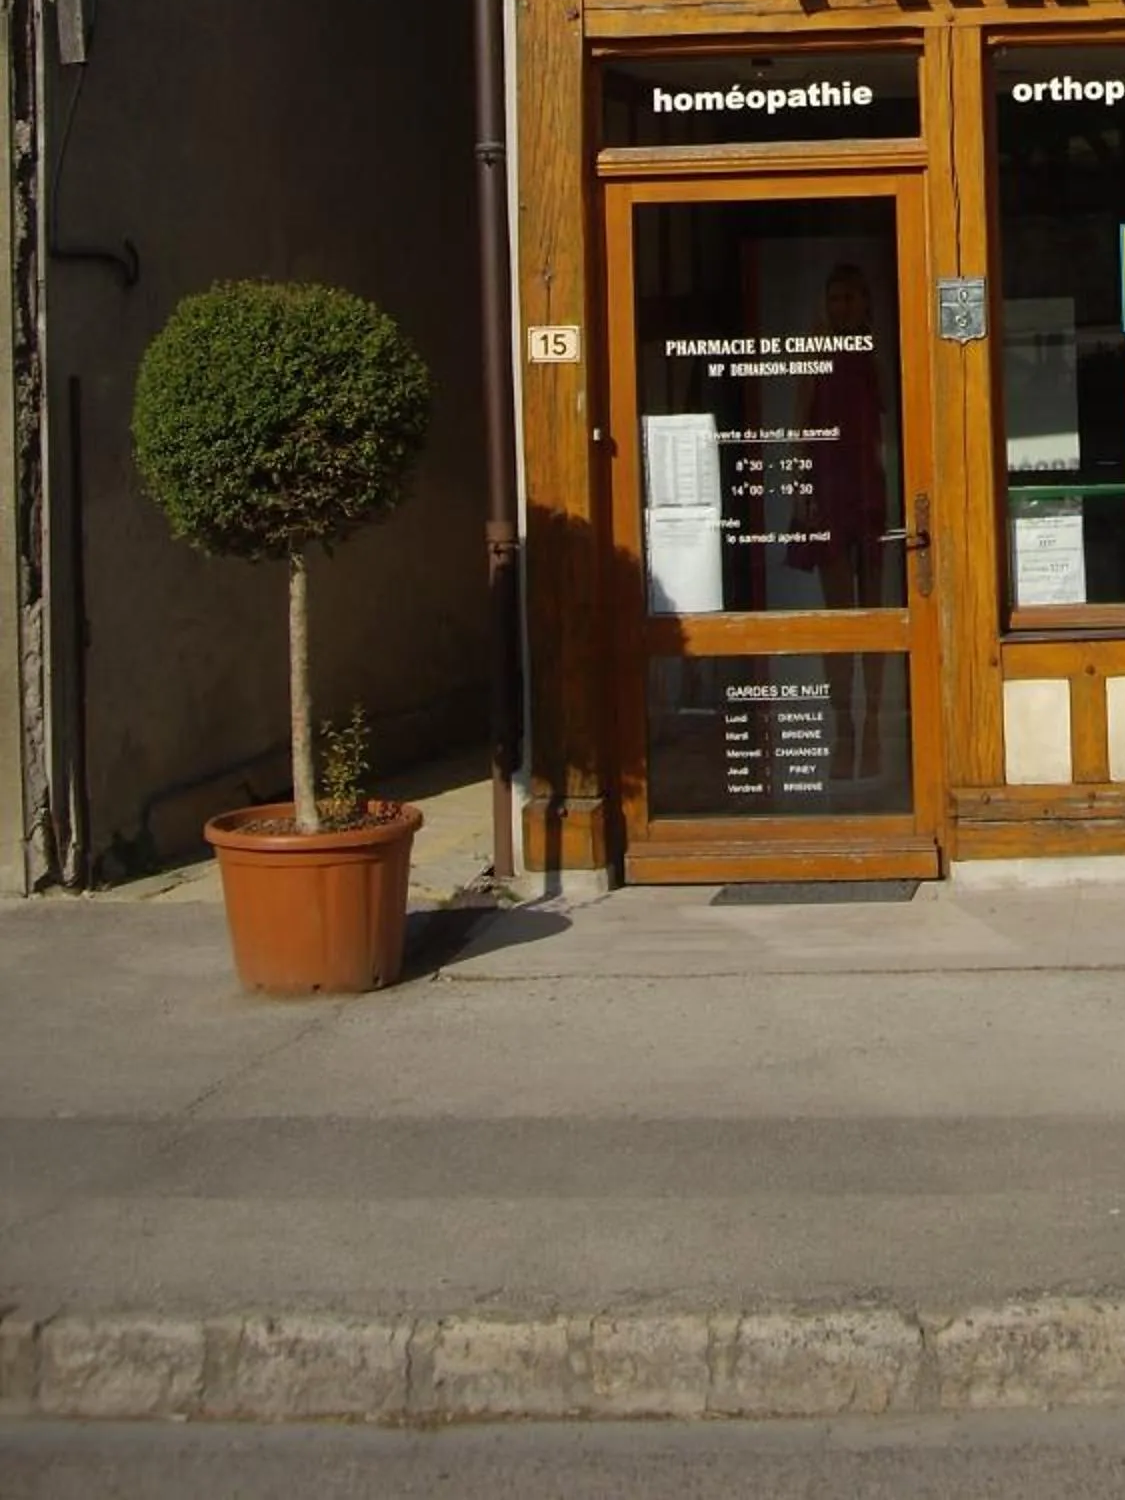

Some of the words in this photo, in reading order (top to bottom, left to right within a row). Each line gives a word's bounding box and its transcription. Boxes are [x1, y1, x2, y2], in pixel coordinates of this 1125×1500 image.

[653, 81, 872, 114] homéopathie
[539, 333, 567, 356] 15
[665, 338, 756, 356] PHARMACIE
[760, 337, 781, 354] DE
[785, 335, 874, 353] CHAVANGES
[708, 363, 725, 377] MP
[744, 428, 759, 439] du
[760, 428, 784, 439] lundi
[802, 426, 840, 438] samedi
[739, 531, 775, 543] samedi
[726, 685, 778, 697] GARDES
[781, 684, 799, 697] DE
[801, 683, 831, 696] NUIT
